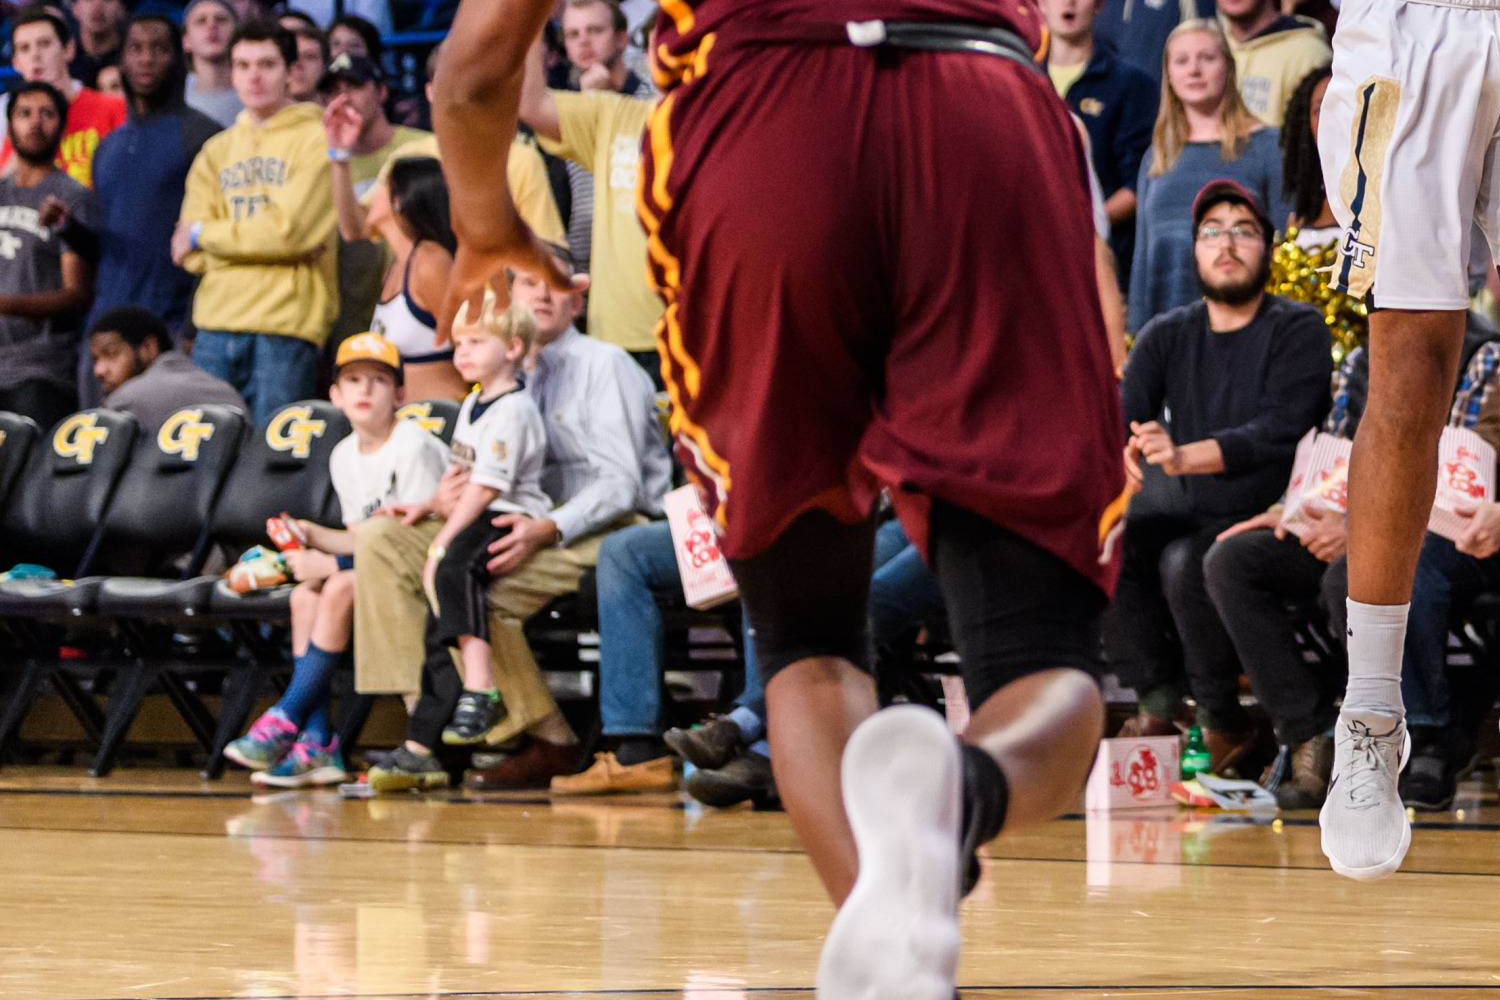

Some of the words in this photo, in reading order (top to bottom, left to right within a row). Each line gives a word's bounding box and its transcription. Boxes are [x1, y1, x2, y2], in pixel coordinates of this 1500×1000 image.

[1340, 226, 1376, 269] GT
[52, 412, 109, 465] GT
[157, 408, 215, 462] GT
[265, 405, 327, 459] GT
